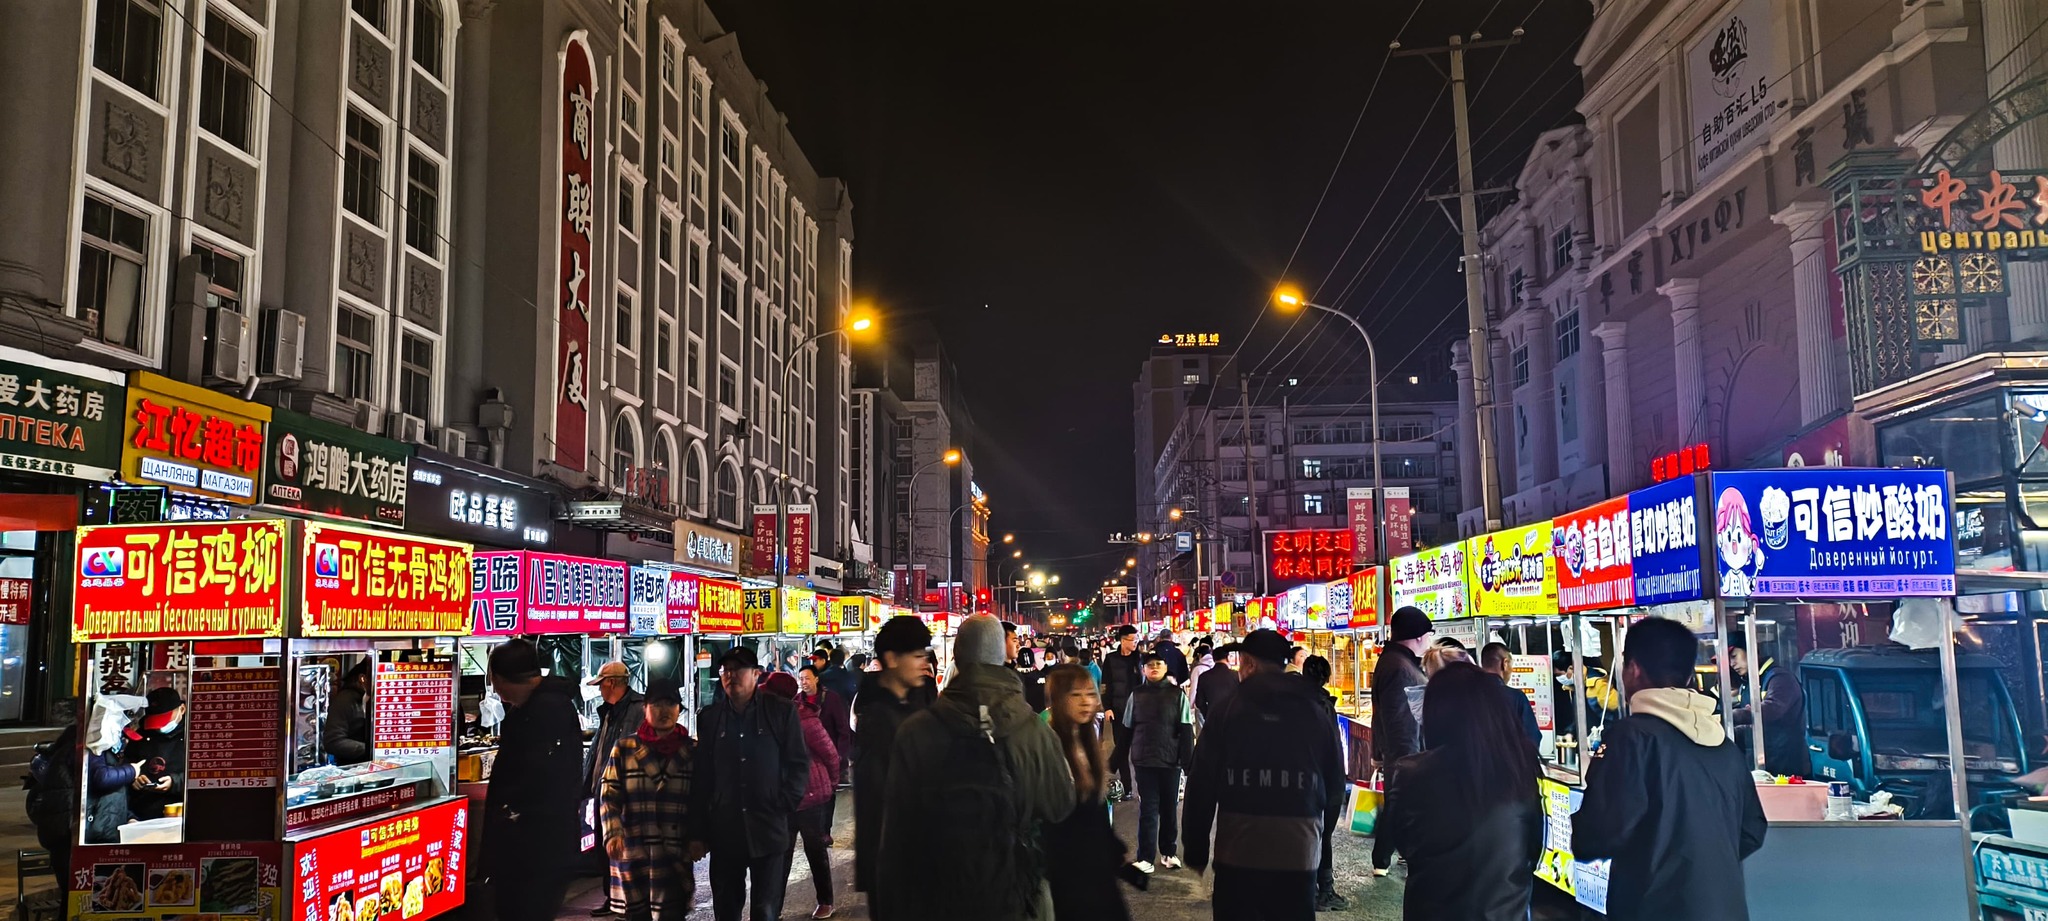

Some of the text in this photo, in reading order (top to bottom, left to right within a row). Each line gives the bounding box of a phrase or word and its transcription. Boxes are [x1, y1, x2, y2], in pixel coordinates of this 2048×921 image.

[1702, 76, 1767, 146] 自助百汇 L5
[1921, 169, 2048, 230] 中央
[559, 84, 593, 412] 商联大厦
[1175, 333, 1219, 343] 万达影城
[0, 374, 105, 421] 爱大药房
[134, 398, 262, 471] 江忆超市
[2, 455, 75, 475] 医保定点单位
[203, 473, 250, 494] МАГАЗИН
[305, 440, 406, 505] 鸿鹏大药房
[273, 486, 300, 499] АПТЕКА
[1792, 482, 1946, 542] 可信炒酸奶
[793, 517, 804, 565] 邮政路夜市
[1274, 534, 1350, 552] 文明交通
[1355, 502, 1367, 554] 邮政路夜市
[1631, 495, 1696, 558] 厚切炒酸奶
[125, 527, 278, 596] 可信鸡柳
[339, 540, 466, 602] 可信无骨鸡柳
[1275, 557, 1353, 576] 你我同行
[1394, 550, 1463, 585] 上海特味鸡柳
[1810, 547, 1938, 570] Доверенный йогурт.
[633, 571, 664, 604] 锅包肉
[745, 590, 771, 609] 夹馍
[83, 599, 274, 638] Доверительный бесконечный куриный
[320, 600, 462, 635] Доверительный бесконечный куриный
